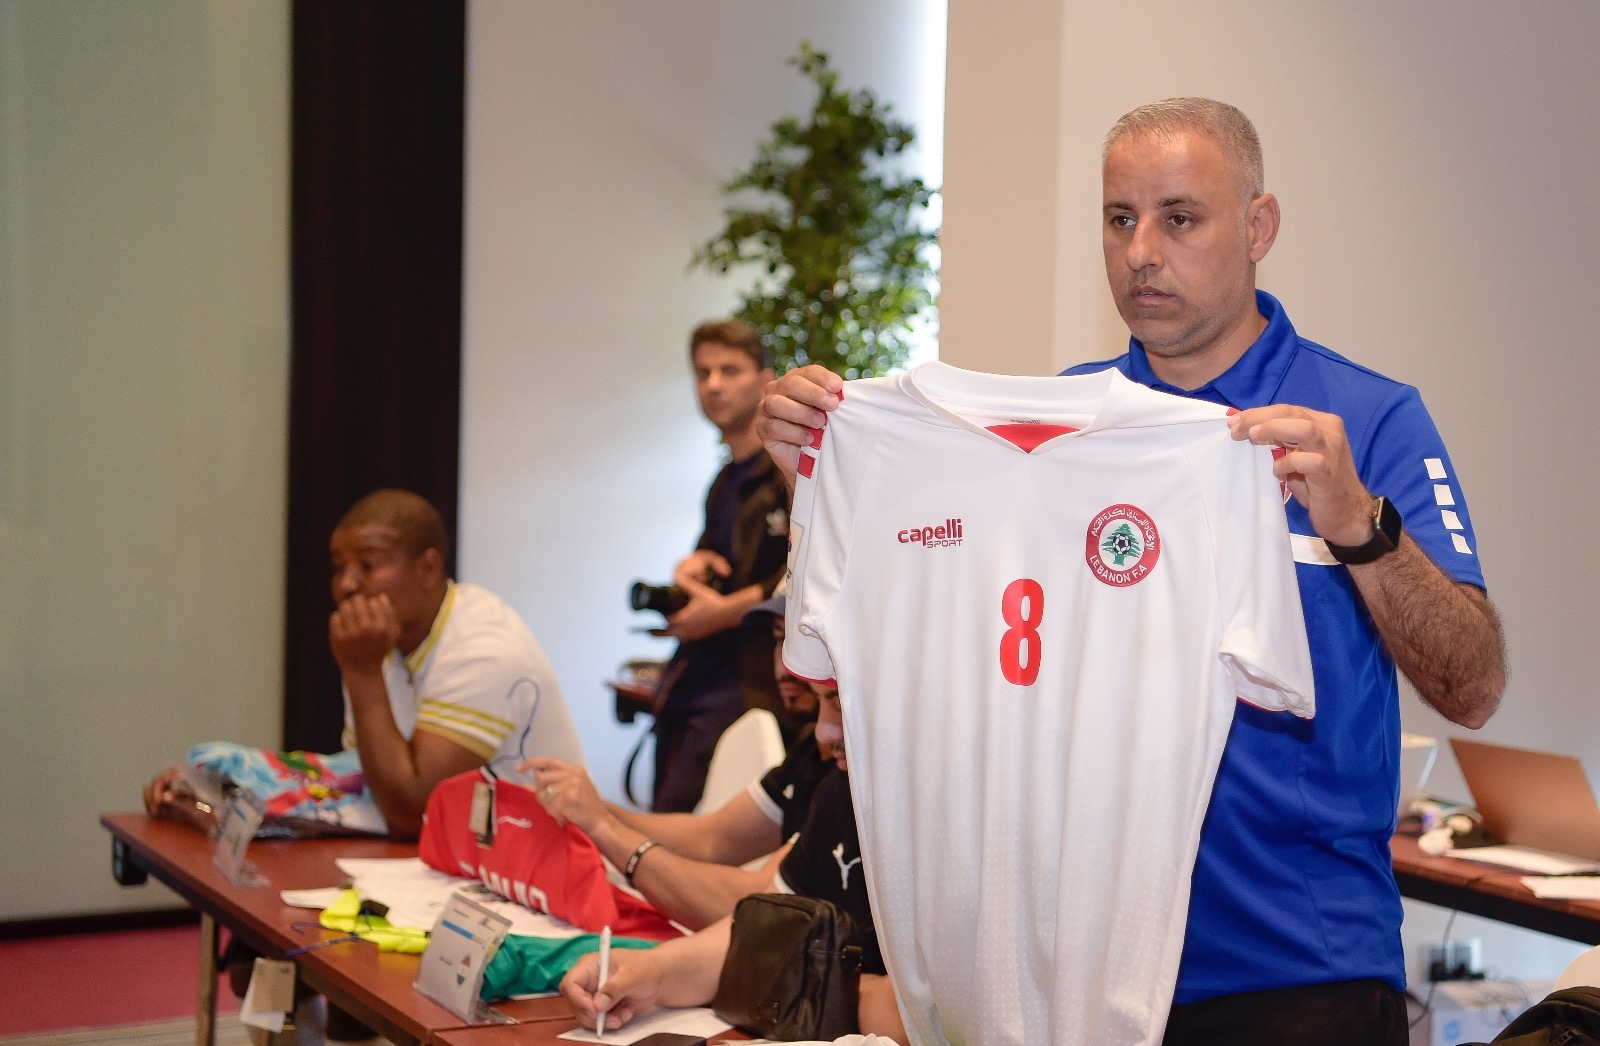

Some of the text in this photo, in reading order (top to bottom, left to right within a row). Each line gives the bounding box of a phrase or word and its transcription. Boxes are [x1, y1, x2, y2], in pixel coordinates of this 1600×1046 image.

[897, 518, 963, 546] capelli
[927, 539, 963, 549] SPORT
[1089, 555, 1148, 583] LEBANON F.A
[999, 578, 1044, 686] 8
